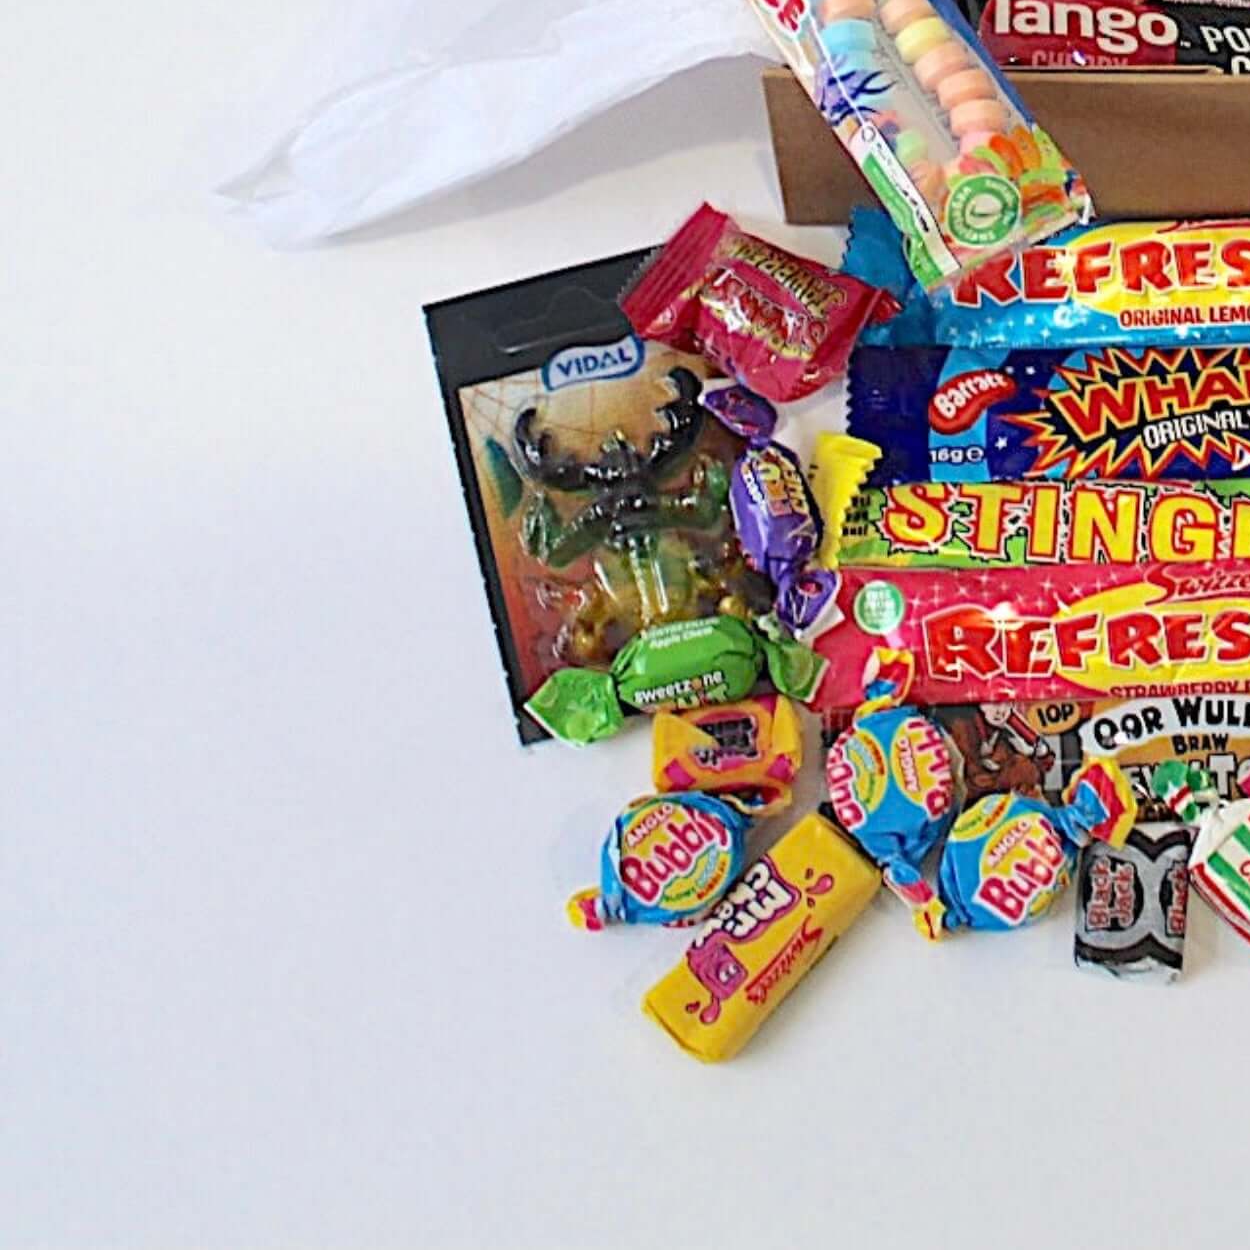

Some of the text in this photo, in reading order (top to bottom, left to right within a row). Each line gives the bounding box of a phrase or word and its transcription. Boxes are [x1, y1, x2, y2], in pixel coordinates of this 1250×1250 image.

[1119, 304, 1205, 327] ORIGINAL
[556, 346, 633, 378] VIDAL
[931, 371, 1007, 418] Barratt
[1143, 411, 1250, 448] ORIGINAL
[1173, 732, 1230, 756] BRAW
[624, 803, 674, 848] ANGLO
[621, 808, 729, 903] Bubbly
[1086, 855, 1111, 930] Black
